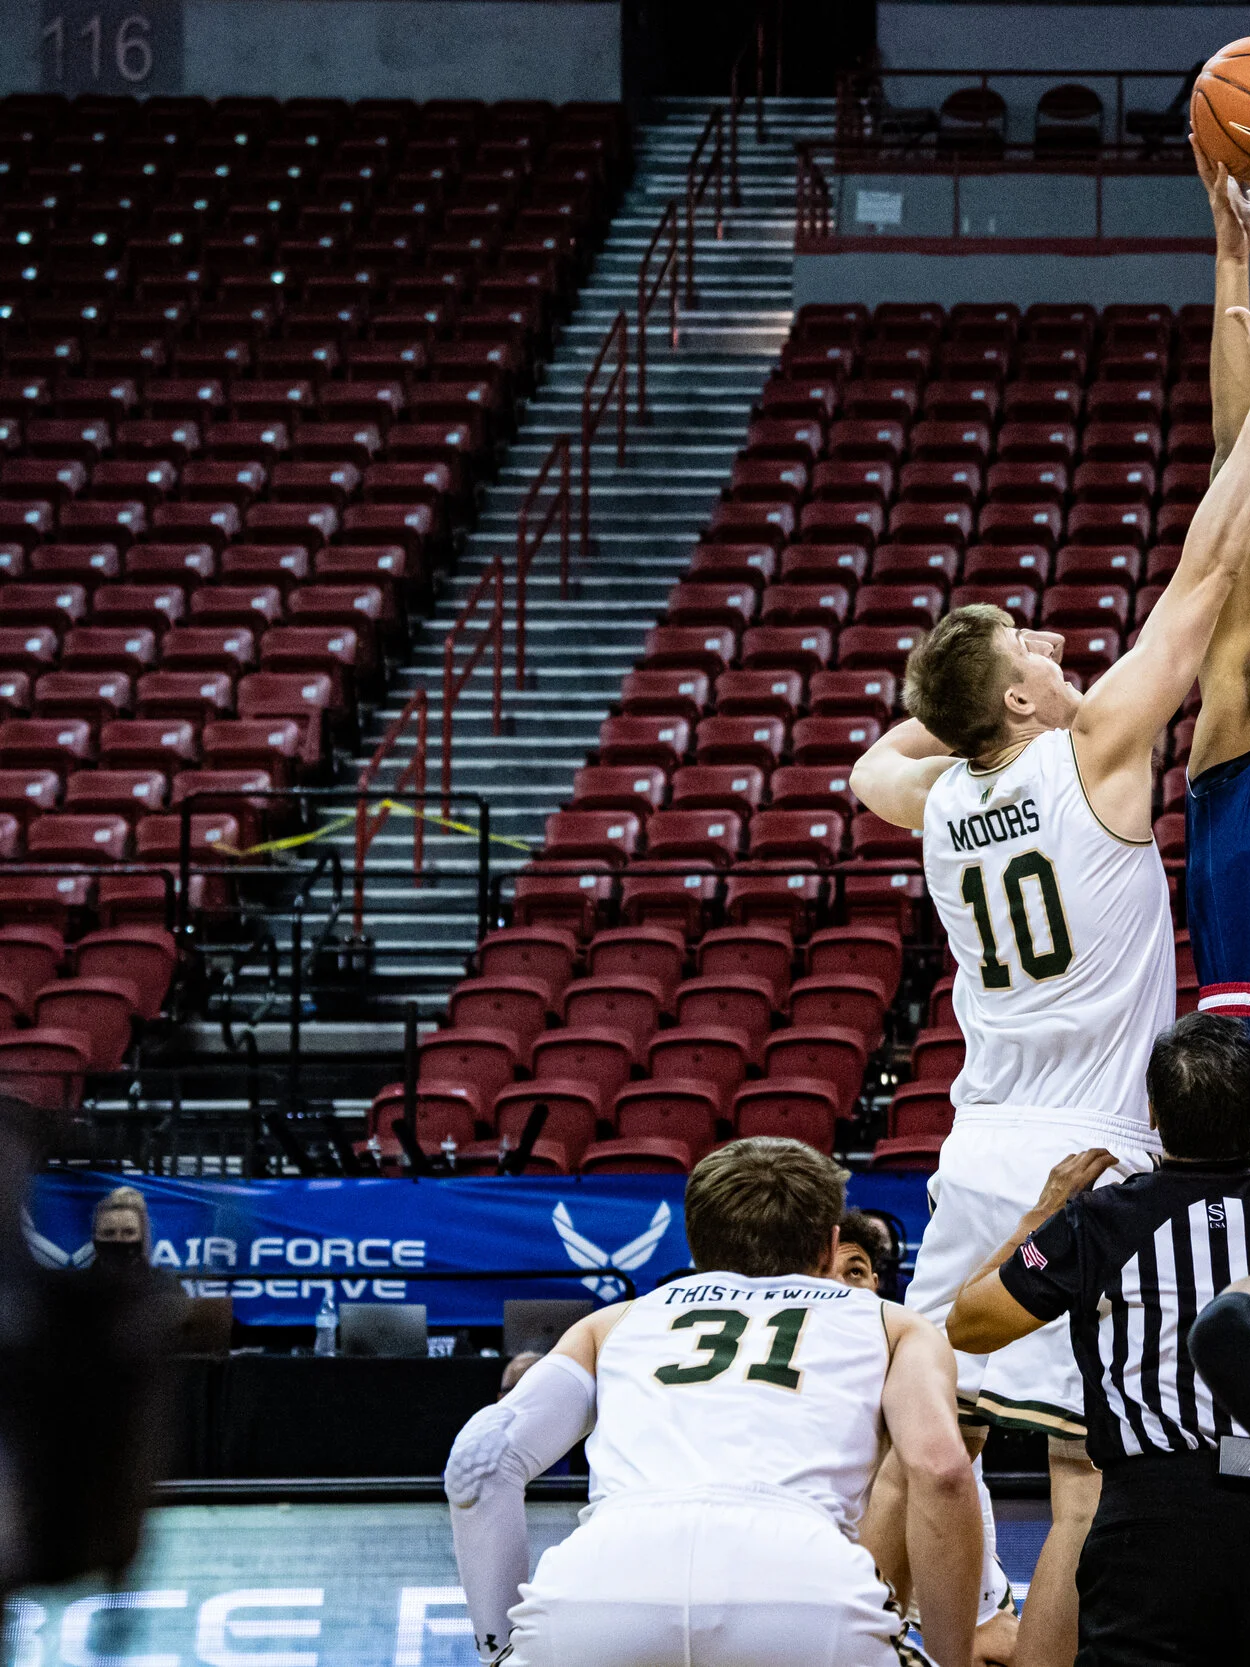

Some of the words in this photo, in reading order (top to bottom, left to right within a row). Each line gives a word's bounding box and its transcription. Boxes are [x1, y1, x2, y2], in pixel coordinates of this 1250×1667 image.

[44, 15, 152, 82] 116
[947, 798, 1040, 852] MOORS
[959, 847, 1076, 992] 10
[150, 1236, 238, 1267] AIR
[250, 1237, 426, 1268] FORCE
[653, 1308, 810, 1394] 31
